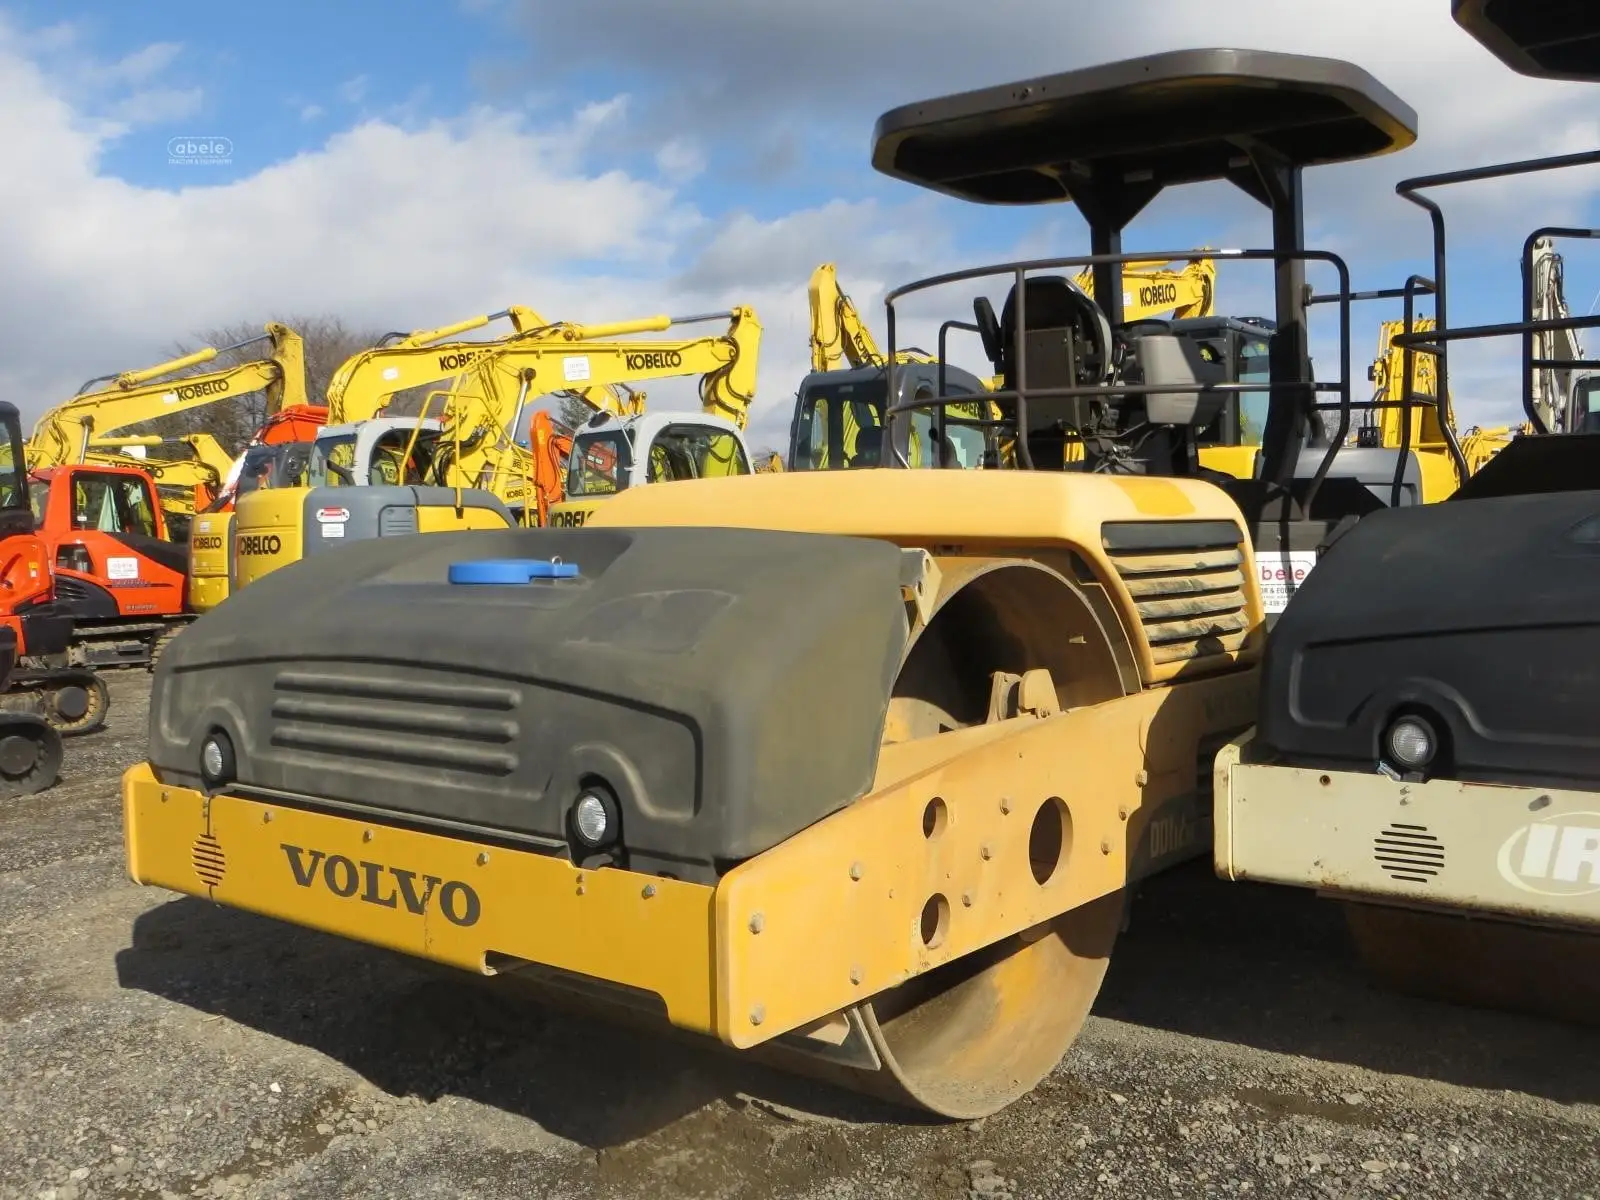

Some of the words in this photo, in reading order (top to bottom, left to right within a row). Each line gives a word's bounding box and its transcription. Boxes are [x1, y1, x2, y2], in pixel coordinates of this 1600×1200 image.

[1139, 283, 1177, 307] KOBELCO
[626, 352, 682, 370] KOBELCO
[175, 379, 230, 401] KOBELCO
[551, 510, 594, 527] KOBEL
[238, 535, 281, 555] OBELCO
[1260, 565, 1305, 580] bele
[1520, 823, 1600, 884] IR
[280, 843, 482, 927] VOLVO
